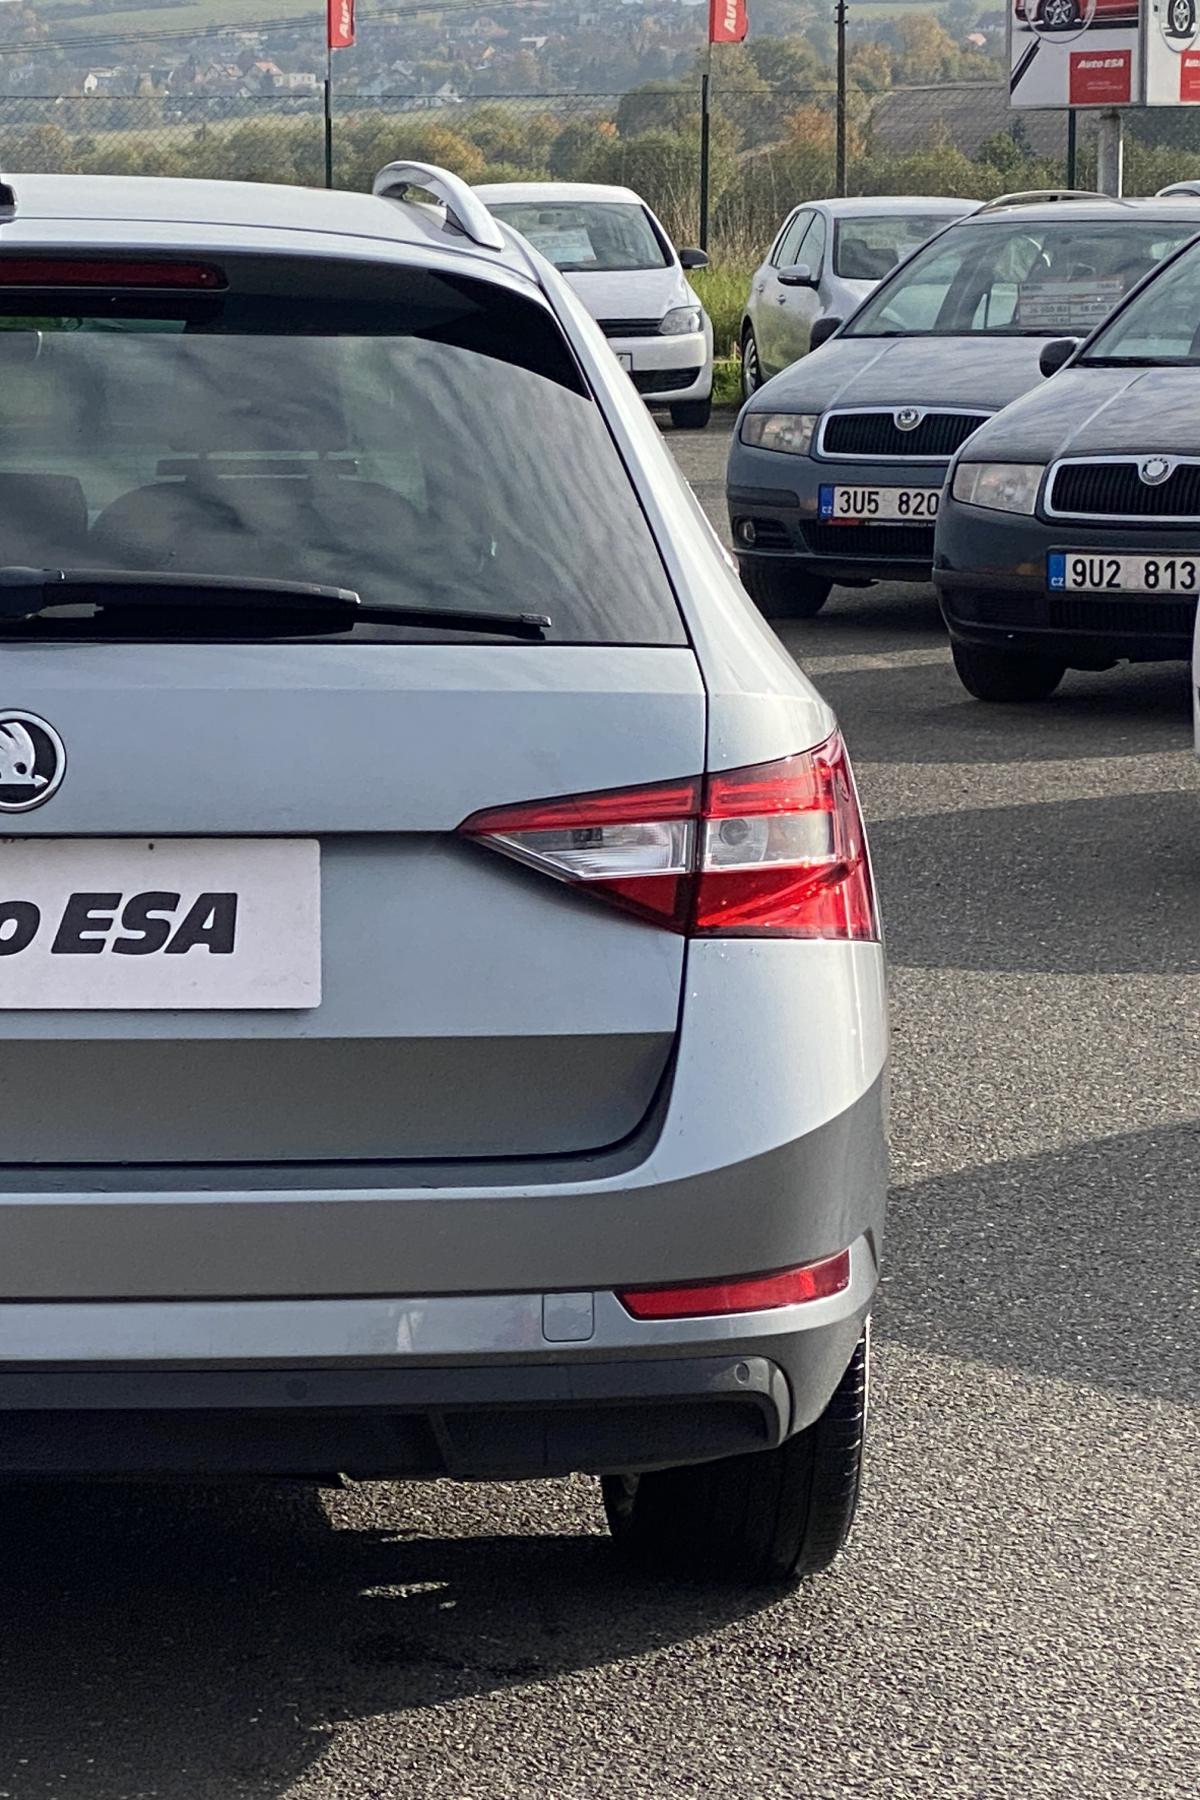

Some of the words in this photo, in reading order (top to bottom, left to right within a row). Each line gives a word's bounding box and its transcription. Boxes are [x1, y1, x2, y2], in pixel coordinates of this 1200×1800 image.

[1077, 59, 1103, 69] Auto
[1104, 58, 1124, 68] ESA
[838, 488, 880, 515] 3U5
[897, 491, 940, 517] 820
[1051, 577, 1064, 587] CZ
[1071, 558, 1121, 588] 9U2
[1144, 560, 1196, 590] 813
[50, 891, 239, 955] ESA
